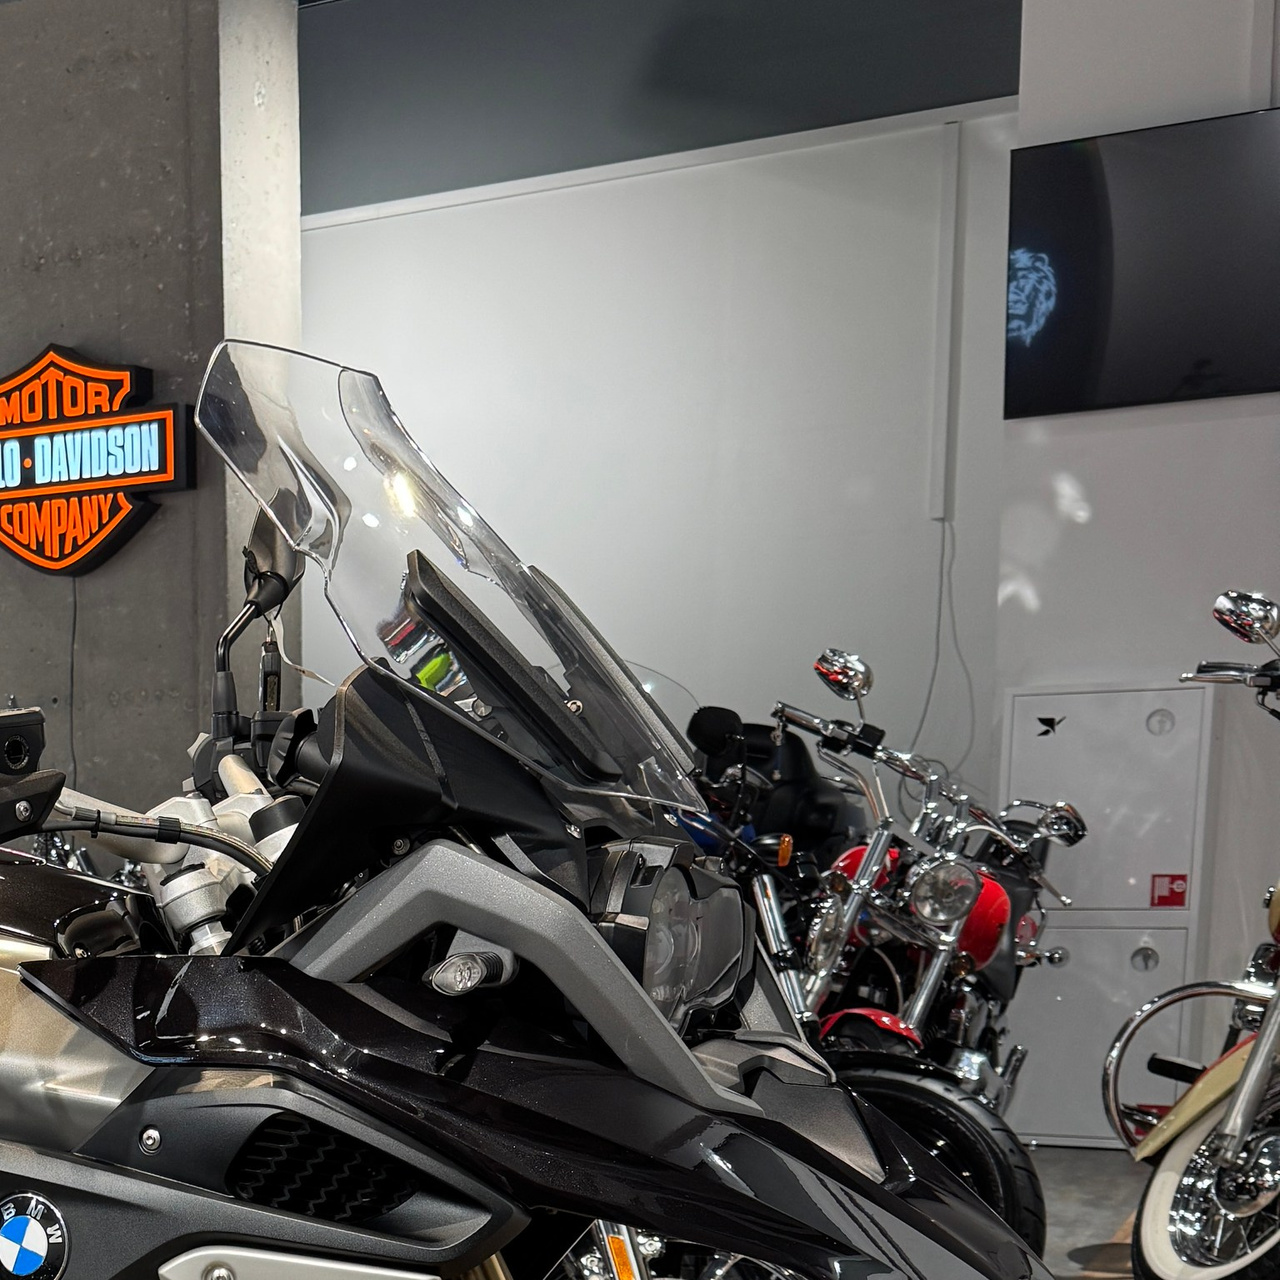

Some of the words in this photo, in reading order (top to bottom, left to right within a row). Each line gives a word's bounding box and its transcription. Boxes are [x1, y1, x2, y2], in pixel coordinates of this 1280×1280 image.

[34, 422, 159, 484] DAVIDSON
[0, 493, 113, 558] COMPANY
[1, 1197, 63, 1244] BMW
